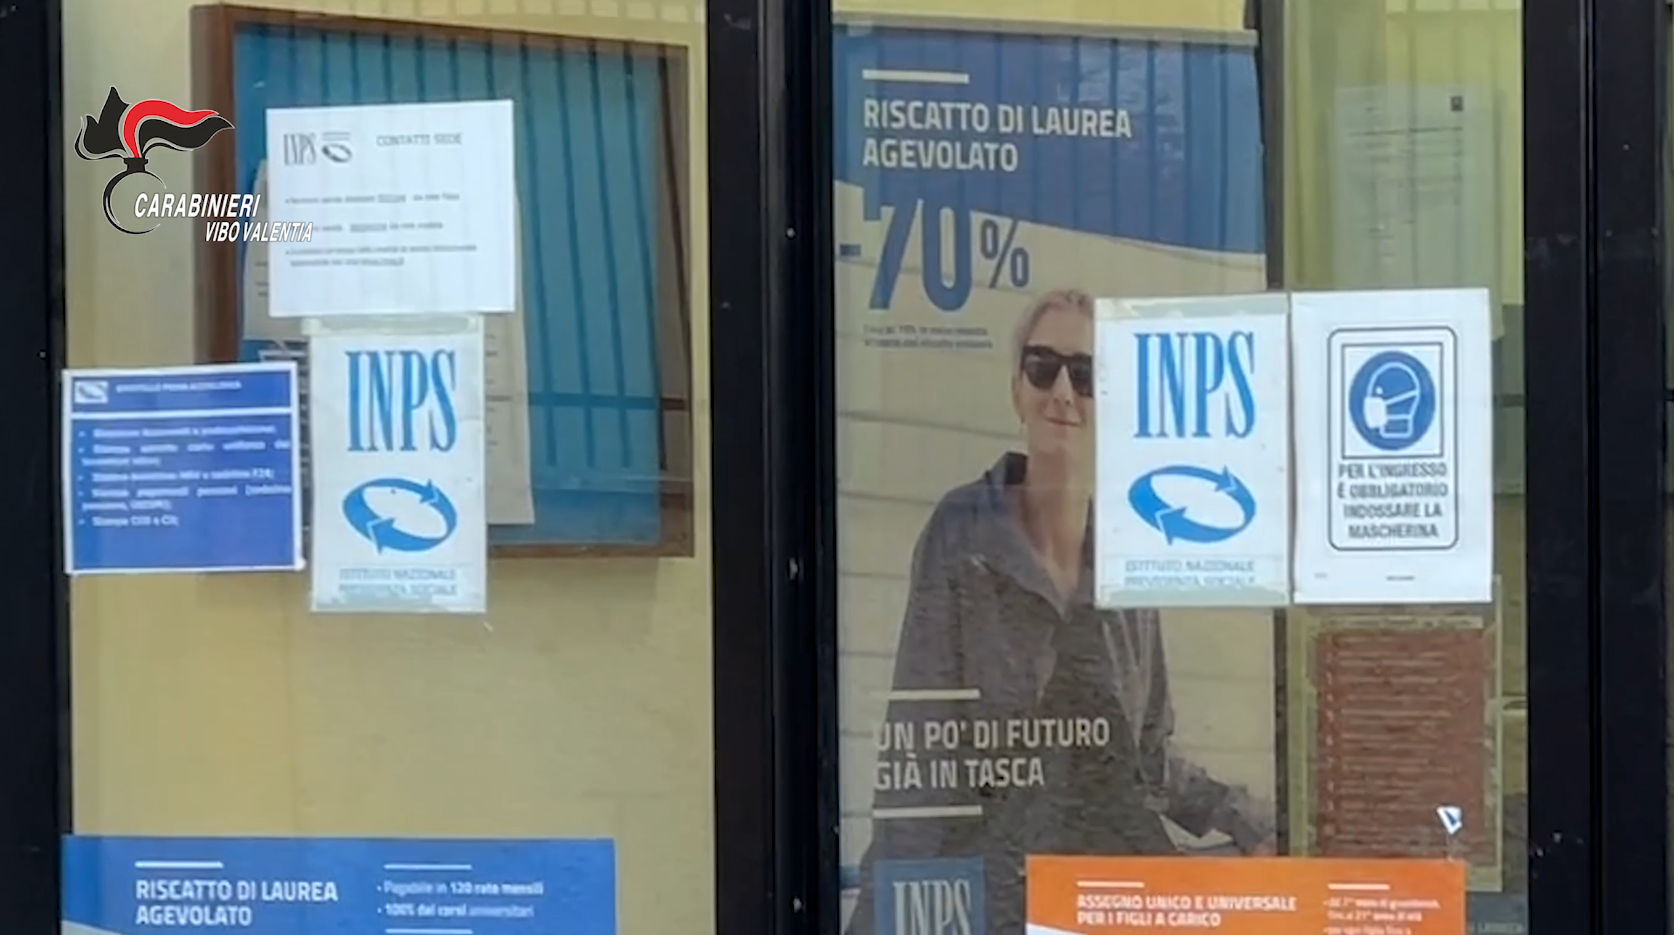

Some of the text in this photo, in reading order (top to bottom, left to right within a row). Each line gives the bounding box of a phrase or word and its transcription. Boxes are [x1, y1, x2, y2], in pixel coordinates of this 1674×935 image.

[863, 98, 1132, 138] RISCATTO DI LAUREA
[283, 132, 316, 166] INPS
[376, 132, 462, 147] CONTATTI SEDE
[863, 138, 1019, 172] AGEVOLATO
[839, 199, 1030, 312] -70%
[1133, 330, 1257, 439] INPS
[345, 348, 457, 452] INPS
[1338, 462, 1447, 478] PER L'INGRESSO
[1350, 483, 1449, 498] OBBLIGATORIO
[1343, 503, 1442, 518] INDOSSARE LA
[1348, 524, 1439, 539] MASCHERINA
[876, 716, 1110, 751] UN PO' DI FUTURO
[874, 752, 1045, 790] GIÀ IN TASCA
[135, 879, 338, 902] RISCATTO DI LAUREA
[1077, 893, 1298, 912] ASSEGNO UNICO E UNIVERSALE
[135, 905, 252, 926] AGEVOLATO
[893, 878, 972, 935] INPS
[1077, 911, 1104, 926] PER
[1116, 911, 1152, 926] FIGLI
[1155, 912, 1164, 925] A
[1168, 911, 1222, 927] CARICO
